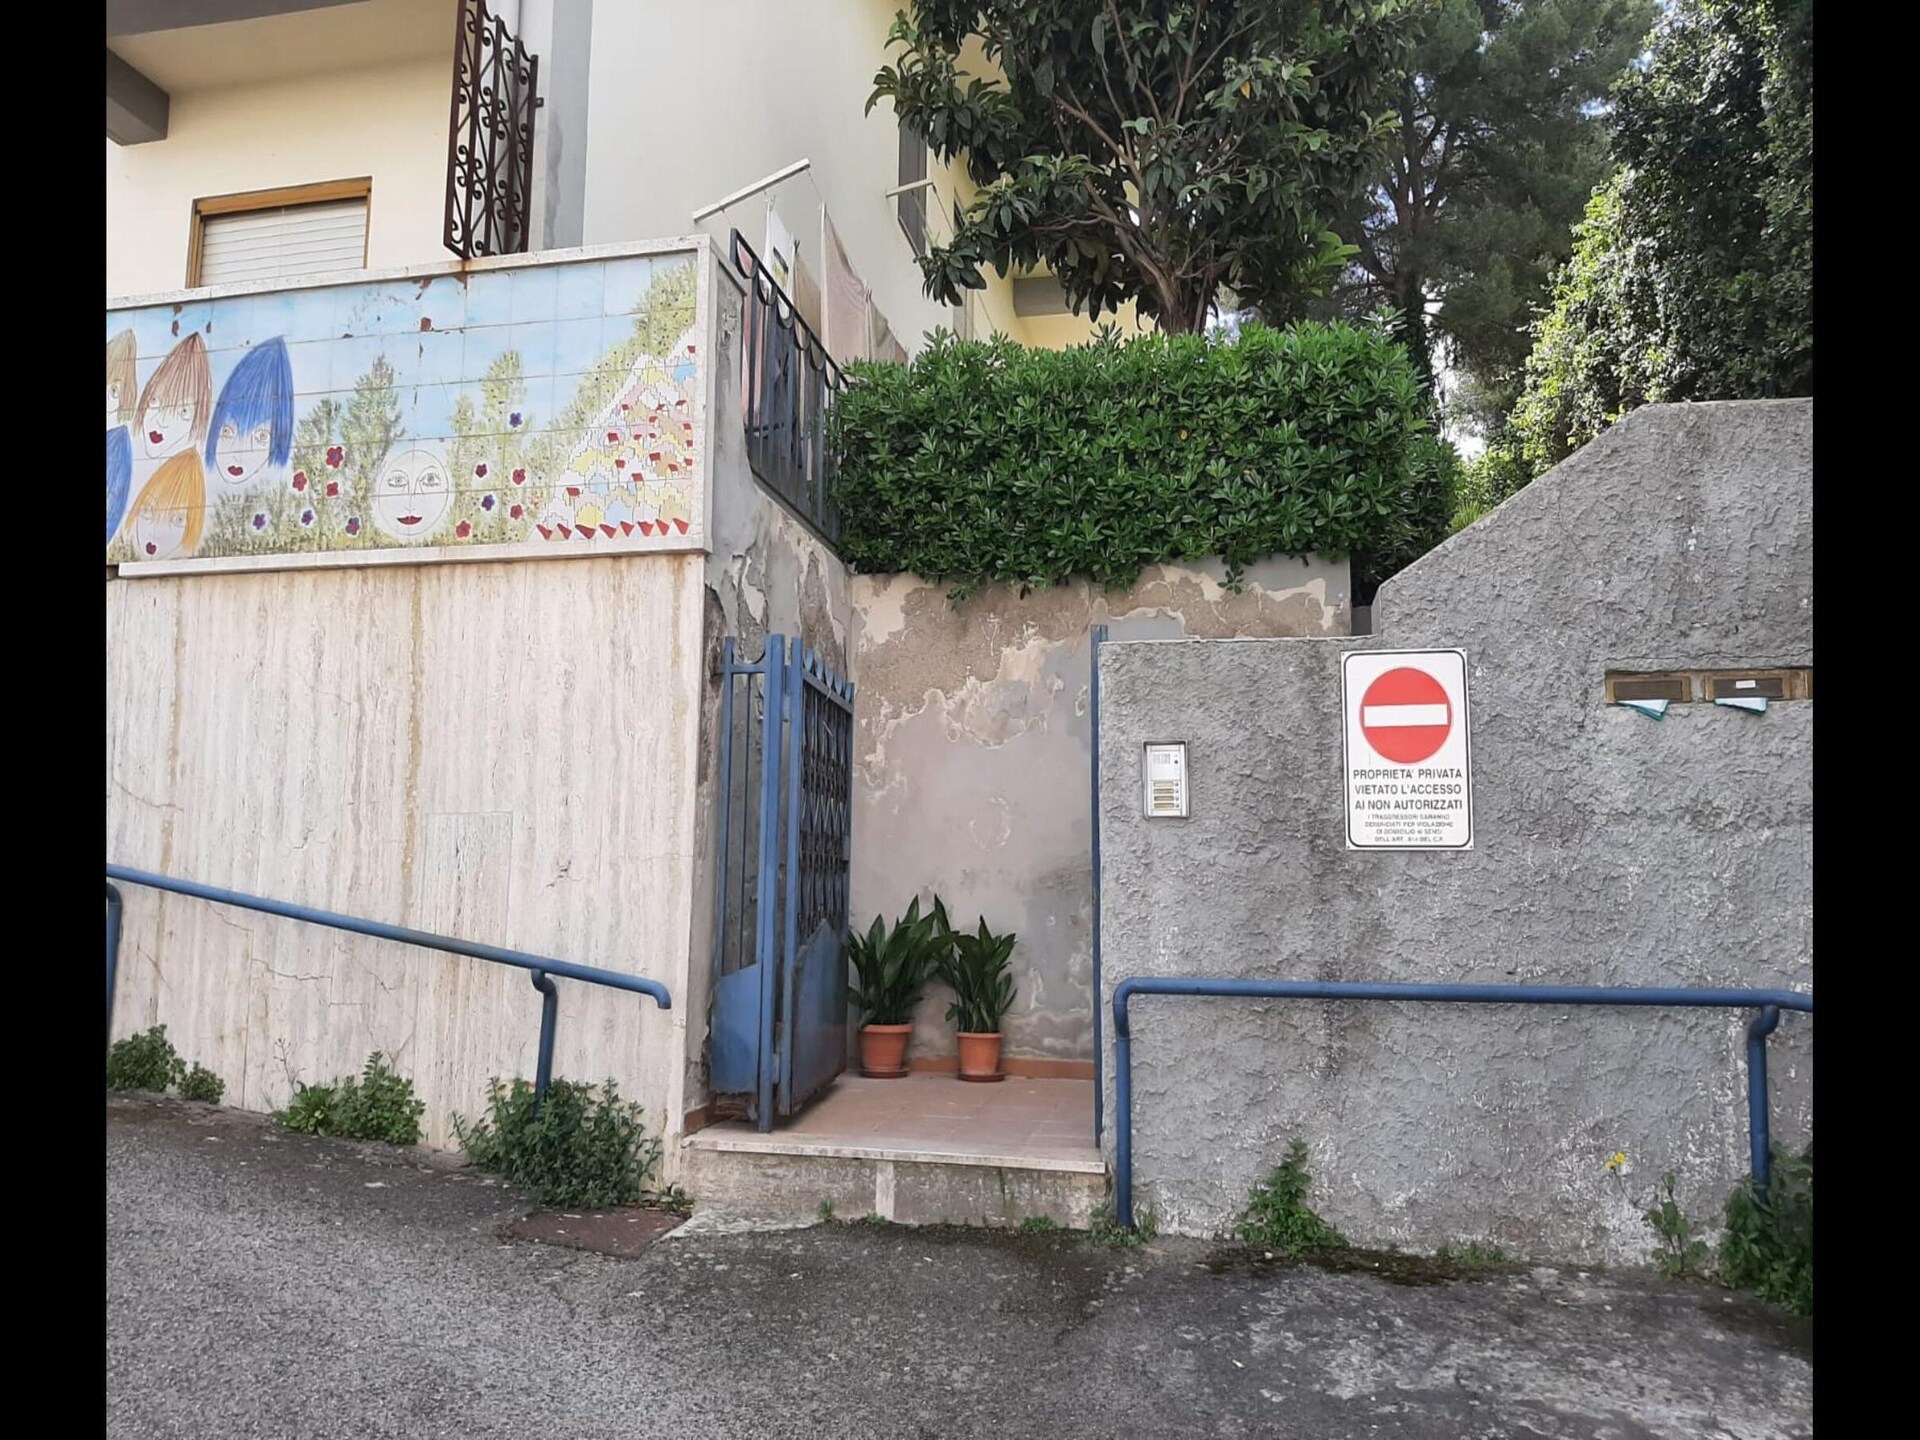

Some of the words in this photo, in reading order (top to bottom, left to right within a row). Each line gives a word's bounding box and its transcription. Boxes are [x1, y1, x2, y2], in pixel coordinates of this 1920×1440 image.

[1418, 768, 1462, 779] PRIVATA
[1355, 785, 1398, 795] VIETATO
[1401, 784, 1462, 795] L'ACCESSO
[1355, 800, 1365, 810] AI
[1368, 800, 1391, 810] NON
[1394, 800, 1463, 810] AUTORIZZATI
